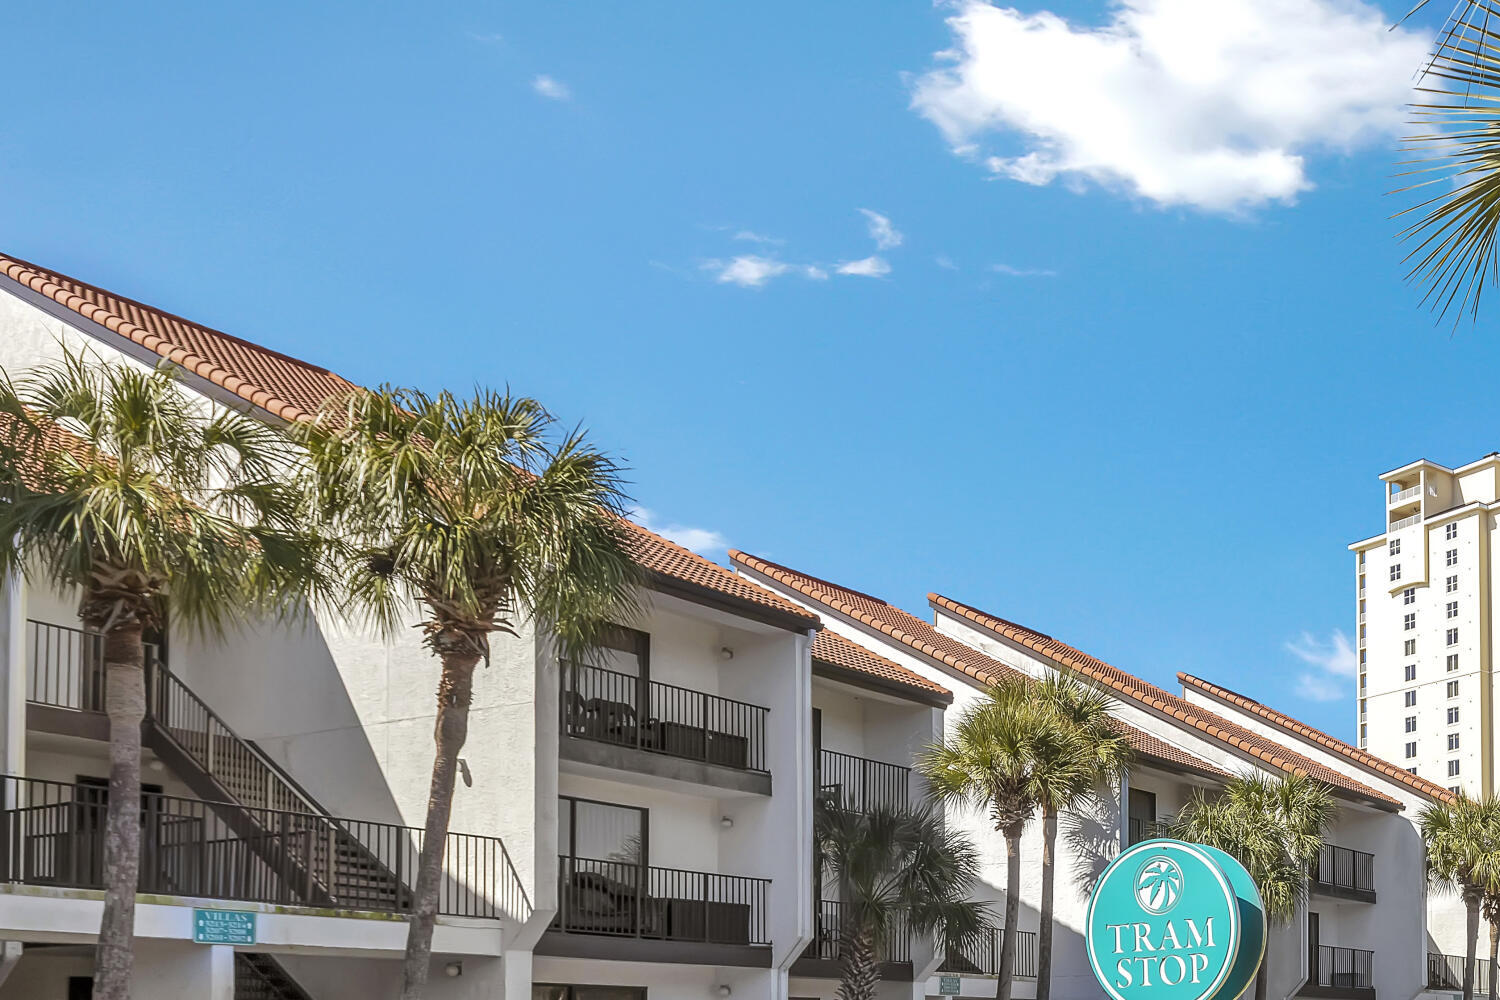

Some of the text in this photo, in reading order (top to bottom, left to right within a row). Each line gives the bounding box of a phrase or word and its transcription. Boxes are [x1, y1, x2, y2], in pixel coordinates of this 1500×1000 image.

[204, 911, 248, 921] VILLAS
[1106, 917, 1216, 954] TRAM
[1116, 953, 1208, 989] STOP
